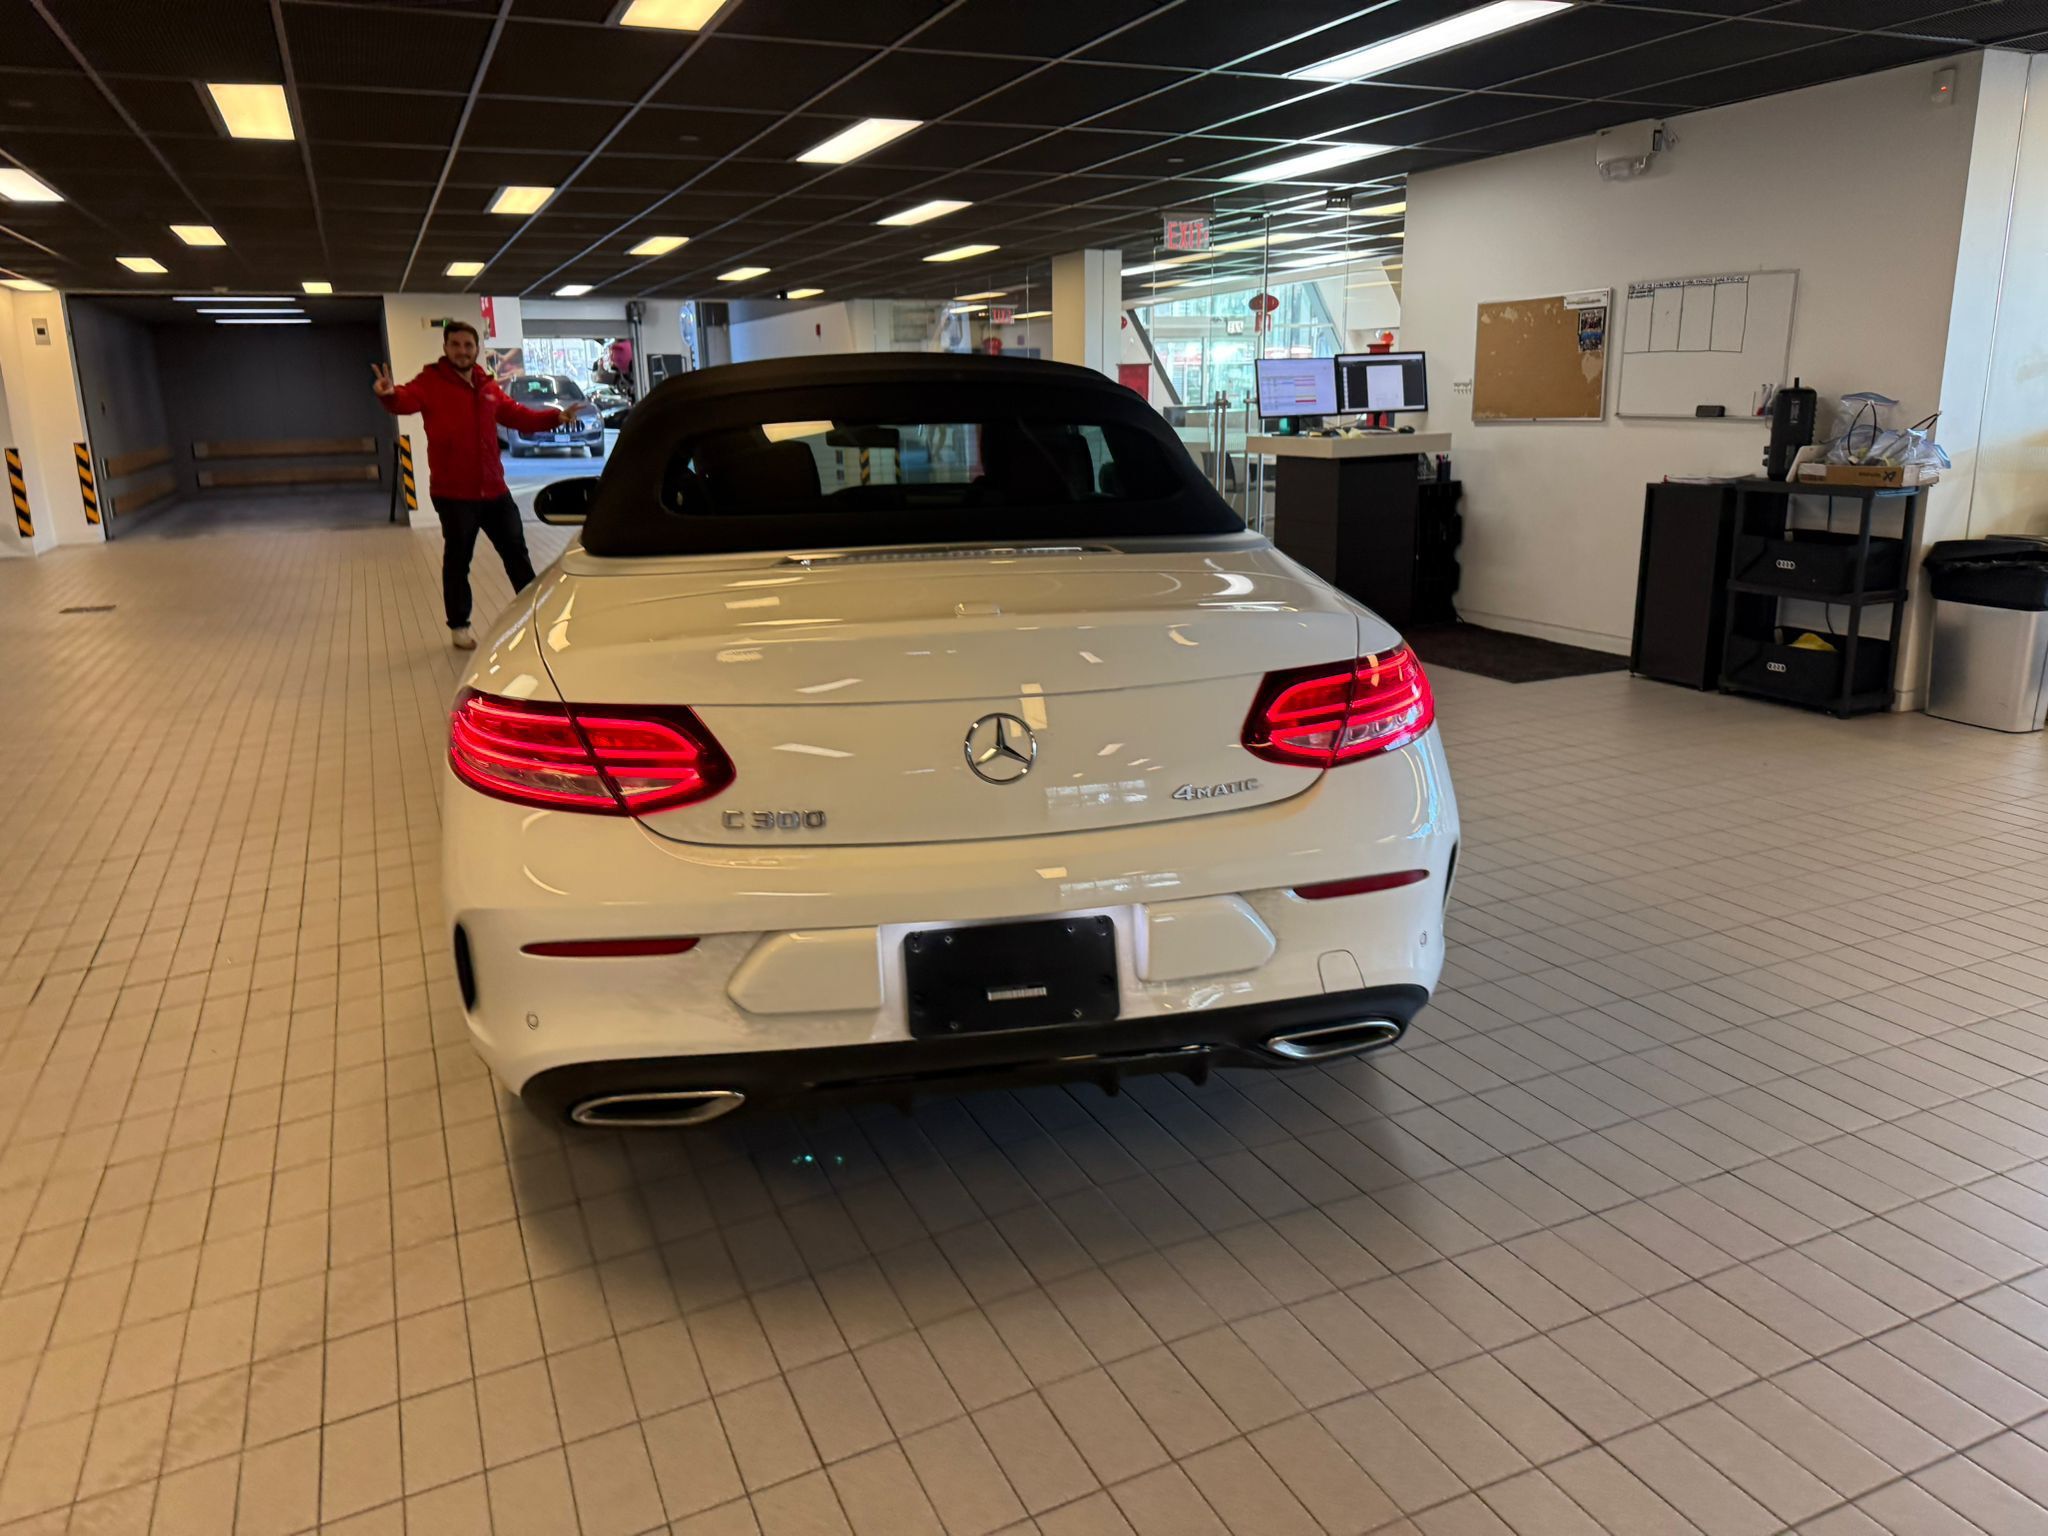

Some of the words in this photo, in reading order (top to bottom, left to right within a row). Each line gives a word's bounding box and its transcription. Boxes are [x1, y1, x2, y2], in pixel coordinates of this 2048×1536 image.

[1167, 221, 1203, 249] EXIT
[1172, 778, 1259, 800] 4MATIC
[722, 809, 745, 829] C
[753, 809, 826, 829] 300
